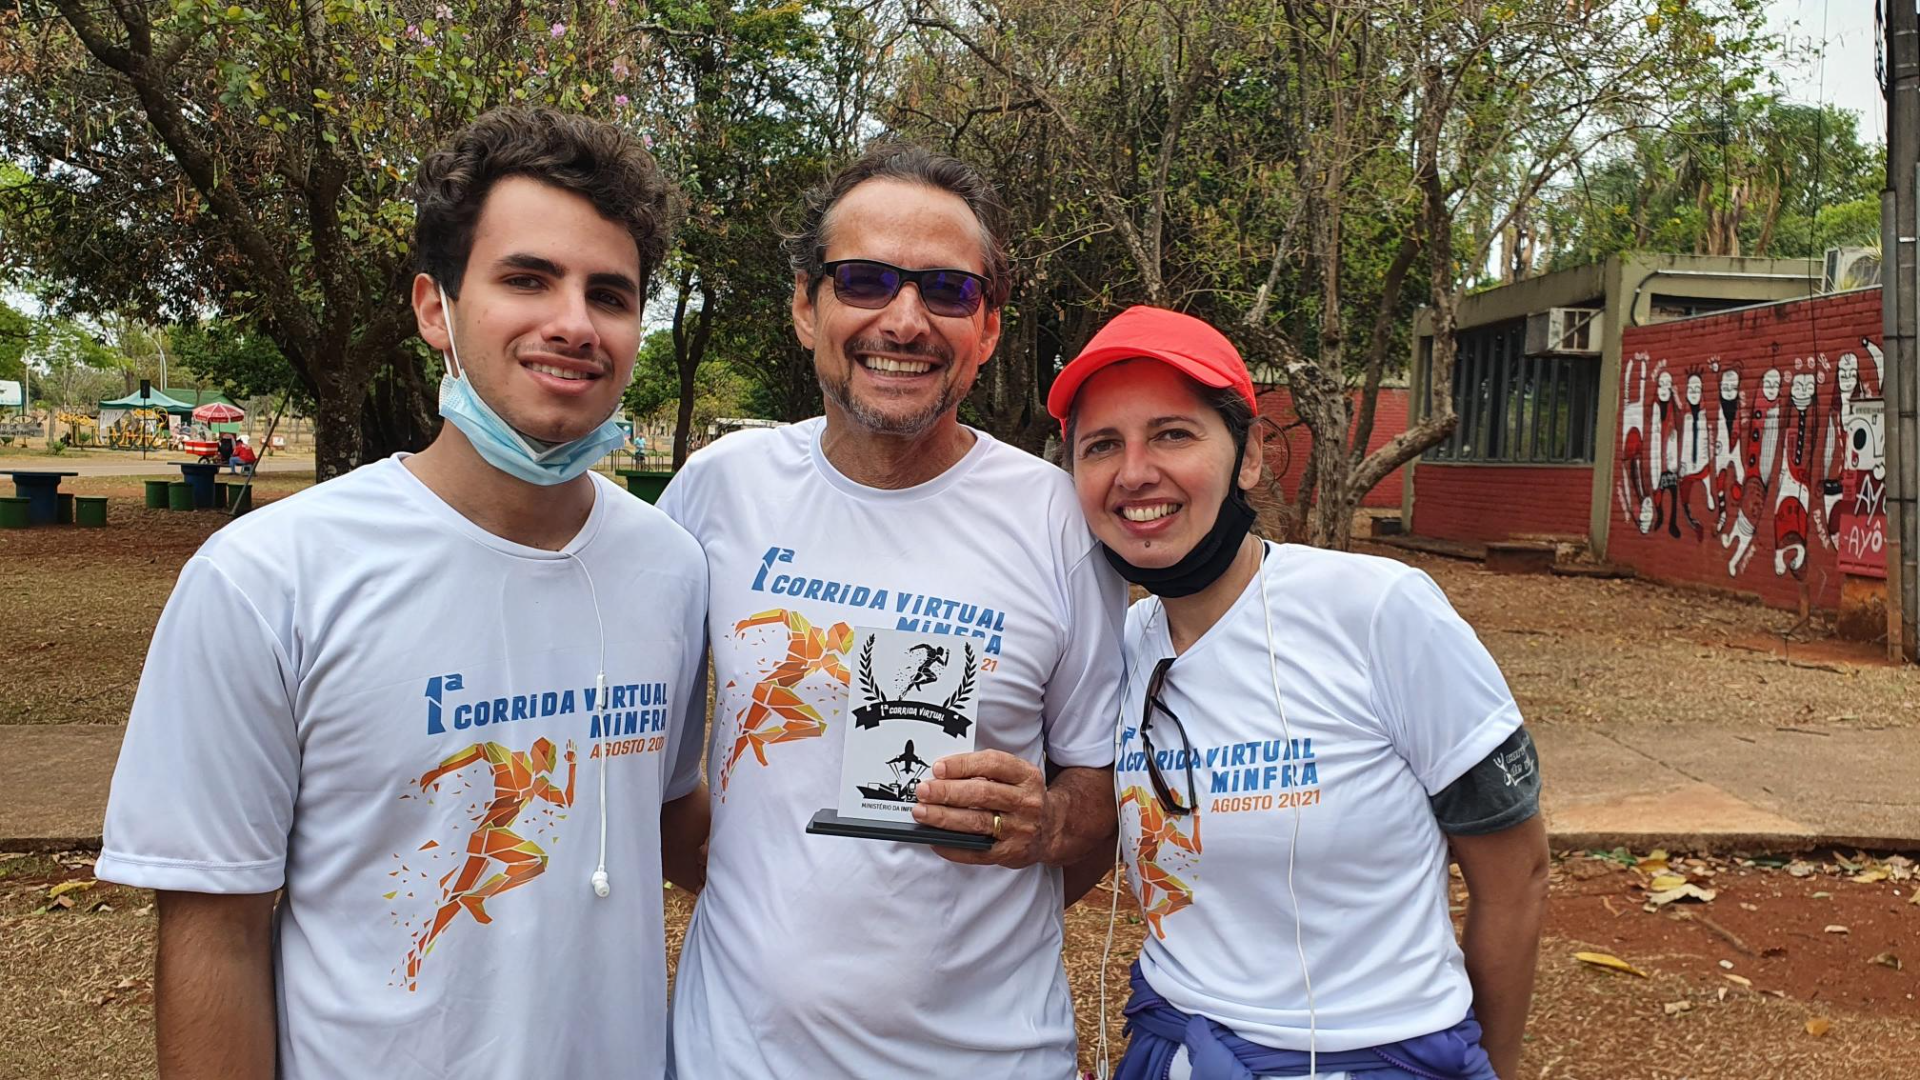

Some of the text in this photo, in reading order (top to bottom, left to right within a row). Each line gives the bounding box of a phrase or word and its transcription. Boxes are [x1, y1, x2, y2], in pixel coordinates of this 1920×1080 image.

[1854, 474, 1886, 526] AY
[590, 738, 646, 759] AGOSTO
[1211, 790, 1321, 813] AGOSTO 2021
